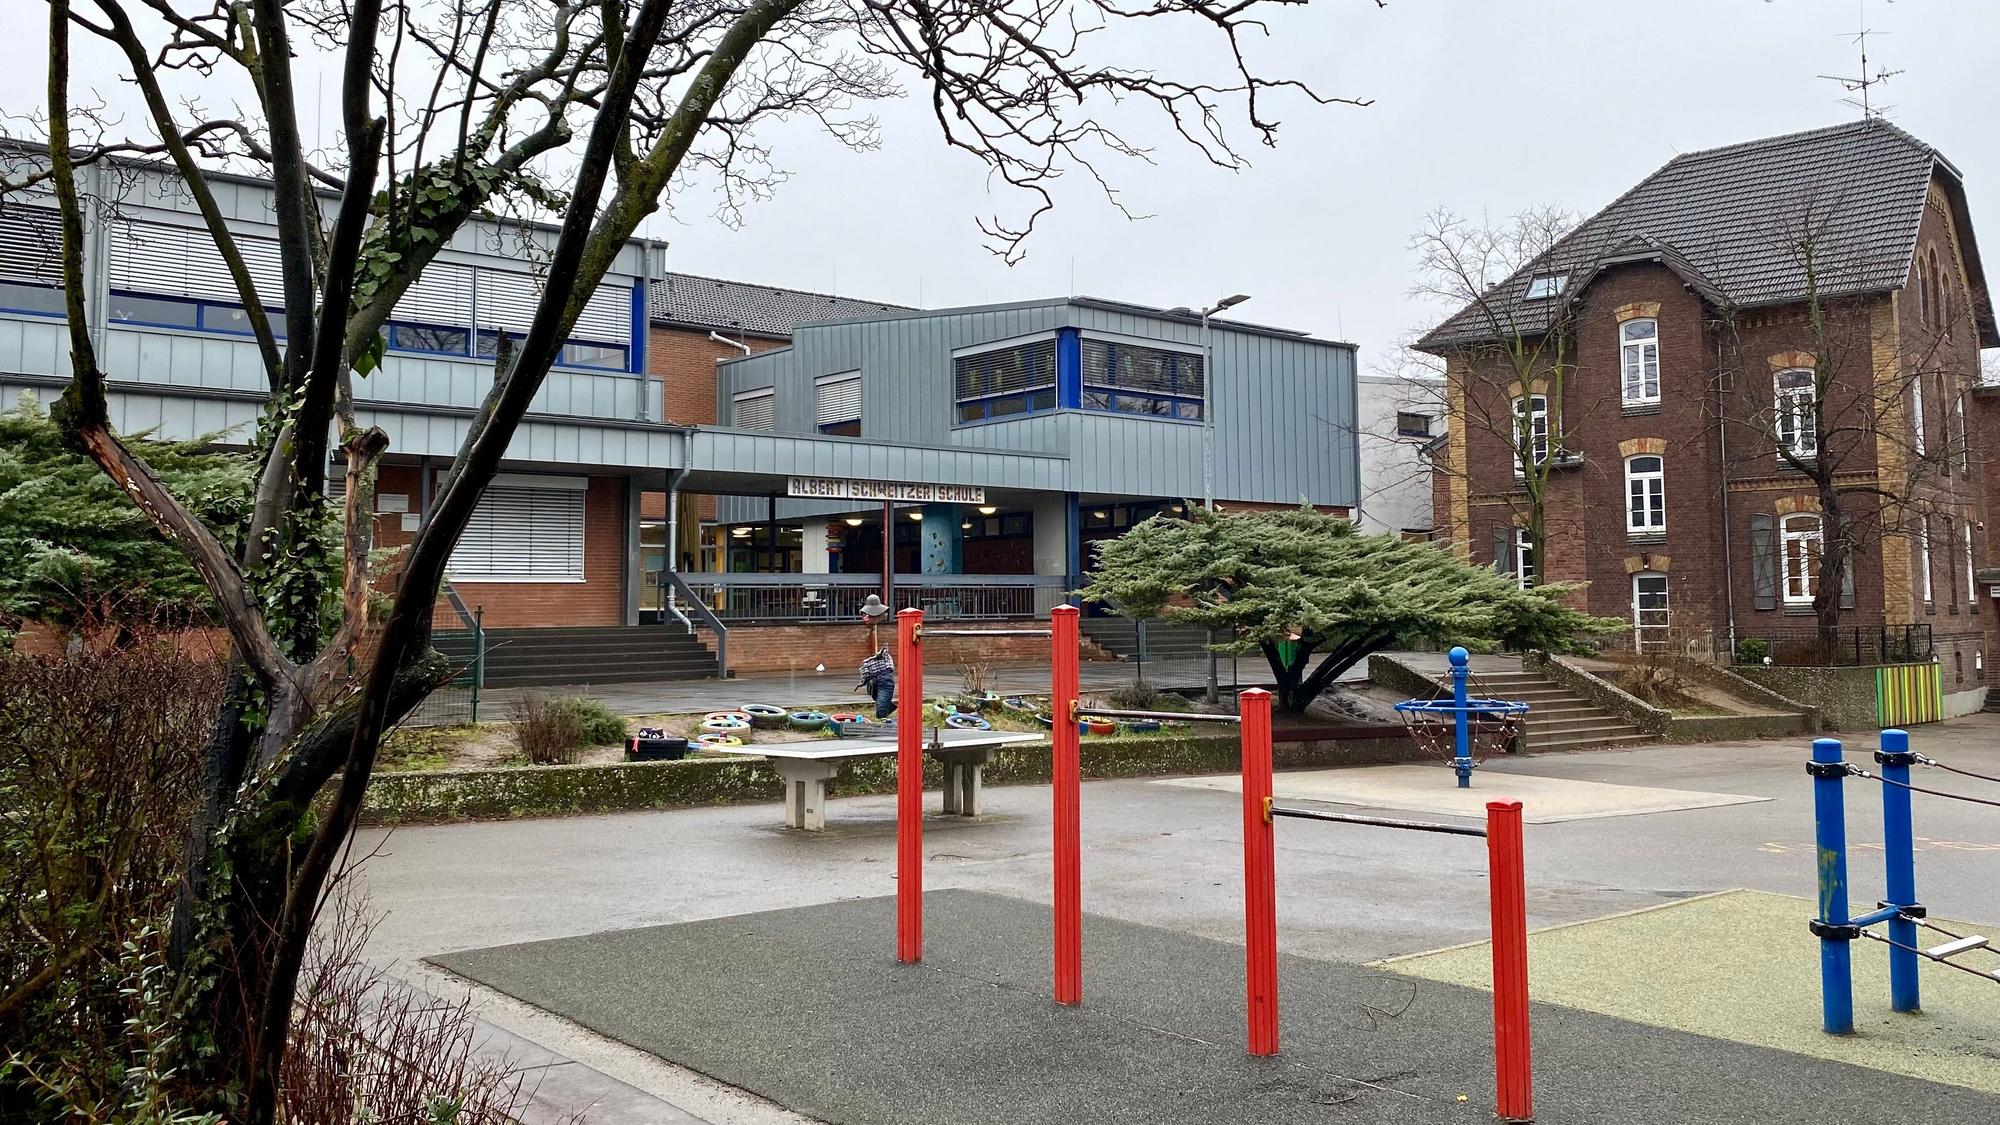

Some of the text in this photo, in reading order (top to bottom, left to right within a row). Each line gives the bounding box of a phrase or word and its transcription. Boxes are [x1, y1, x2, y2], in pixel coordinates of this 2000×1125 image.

[792, 478, 982, 503] ALBERT SCHWEITZER SCHULE
